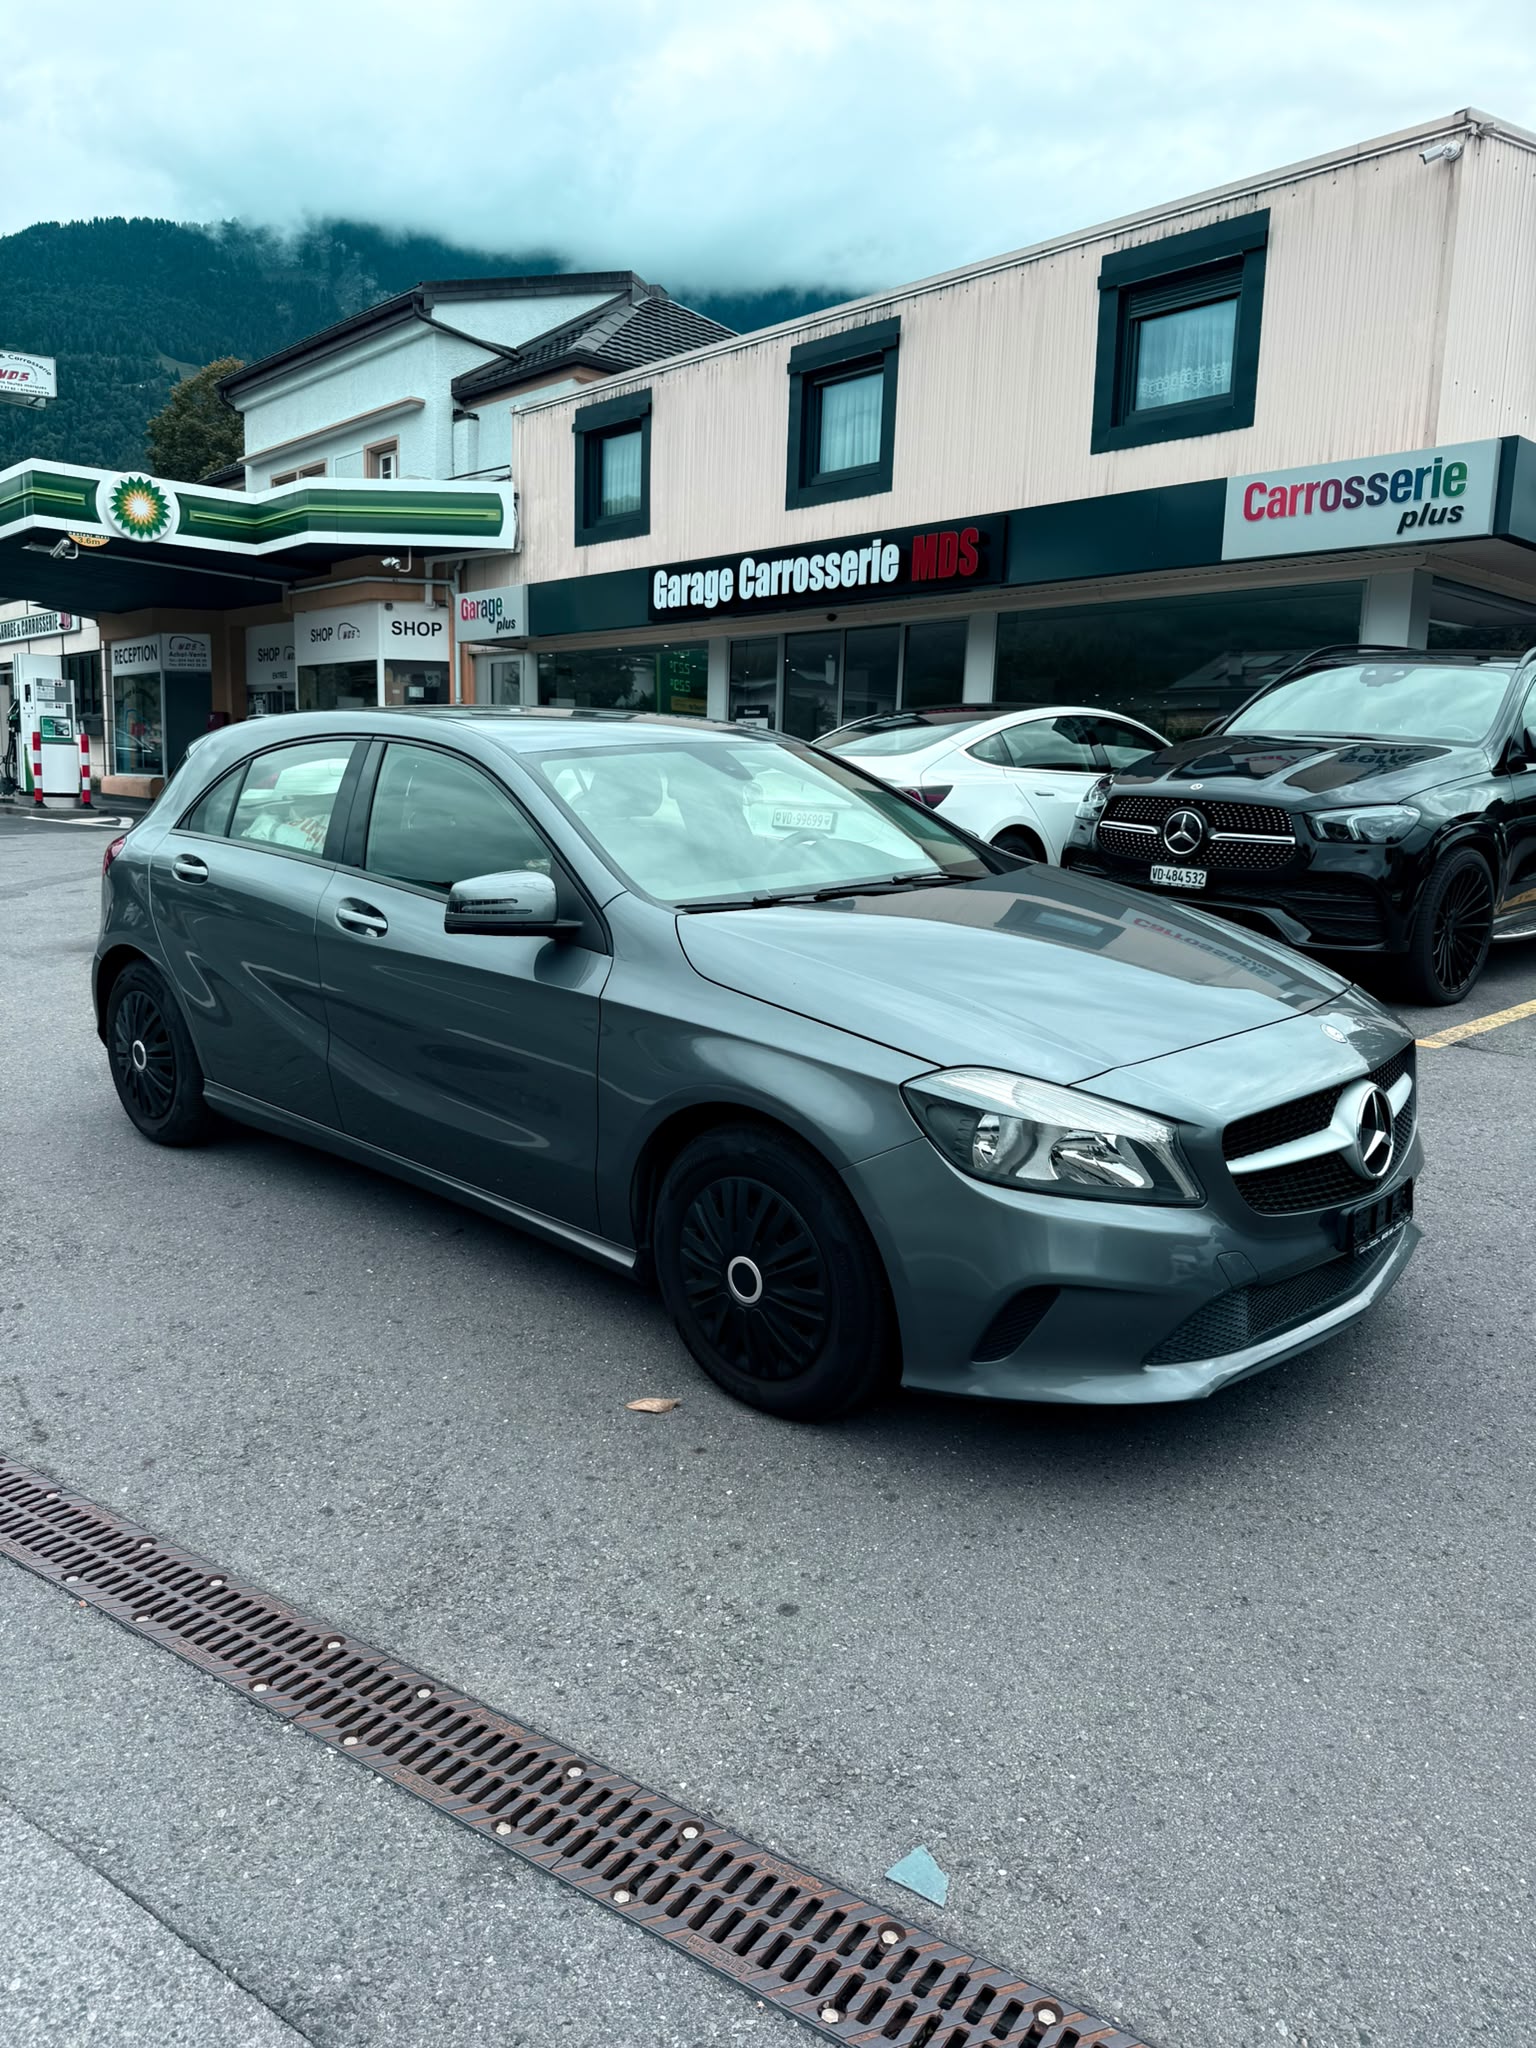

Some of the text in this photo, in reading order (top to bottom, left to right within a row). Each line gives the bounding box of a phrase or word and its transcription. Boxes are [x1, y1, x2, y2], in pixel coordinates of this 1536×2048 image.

[8, 354, 52, 376] Carrosserie
[1243, 456, 1468, 522] Carrosserie
[1396, 502, 1464, 535] plus
[653, 527, 979, 610] Garage Carrosserie MDS
[461, 597, 503, 625] Garage
[310, 627, 334, 642] SHOP
[391, 621, 443, 637] SHOP
[496, 617, 517, 634] plus
[114, 643, 158, 665] RECEPTION
[257, 647, 280, 662] SHOP
